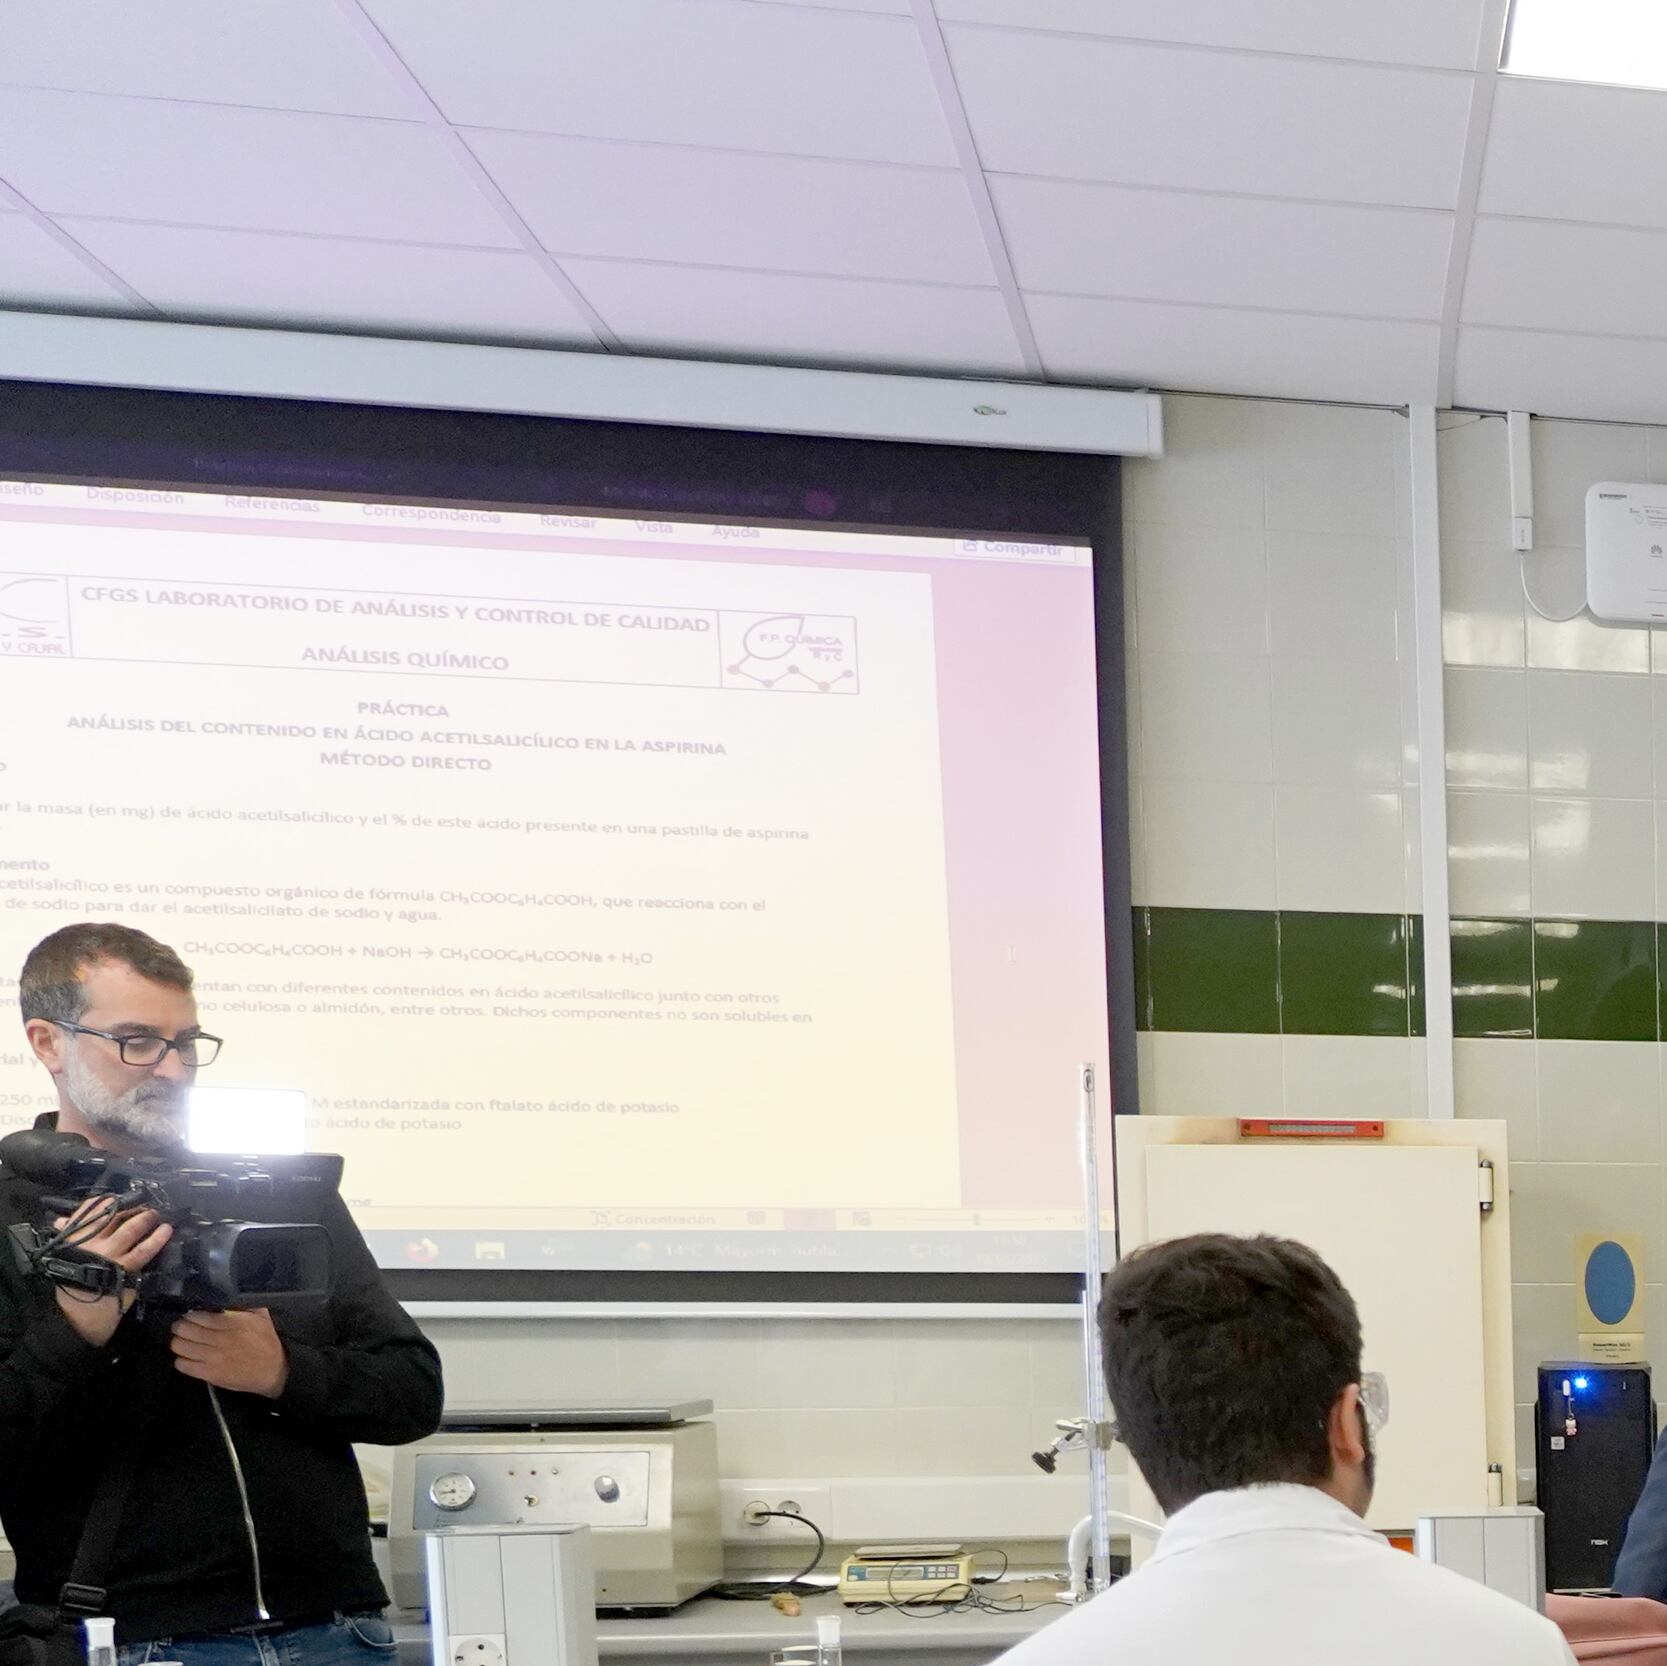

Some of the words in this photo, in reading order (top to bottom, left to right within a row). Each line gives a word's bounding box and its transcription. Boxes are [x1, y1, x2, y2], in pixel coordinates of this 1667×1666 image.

[81, 586, 138, 602] CFGS
[146, 590, 308, 611] LABORATORIO
[315, 598, 344, 613] DE
[351, 598, 449, 619] ANÁLISIS
[456, 605, 469, 620] Y
[474, 607, 577, 625] CONTROL
[584, 611, 612, 628] DE
[618, 614, 710, 632] CALIDAD
[301, 646, 401, 666] ANÁLISIS
[407, 650, 510, 670] QUÍMICO
[358, 699, 449, 717] PRÁCTICA
[67, 713, 155, 731] ANÁLISIS
[160, 719, 196, 733] DEL
[201, 721, 316, 738] CONTENIDO
[323, 726, 348, 739] EN
[354, 724, 414, 742] ÁCIDO
[420, 731, 579, 749] ACETILSALICÍLICO
[585, 737, 609, 750] EN
[614, 738, 636, 751] LA
[642, 740, 726, 754] ASPIRINA
[320, 749, 405, 767] MÉTODO
[412, 755, 492, 770] DIRECTO
